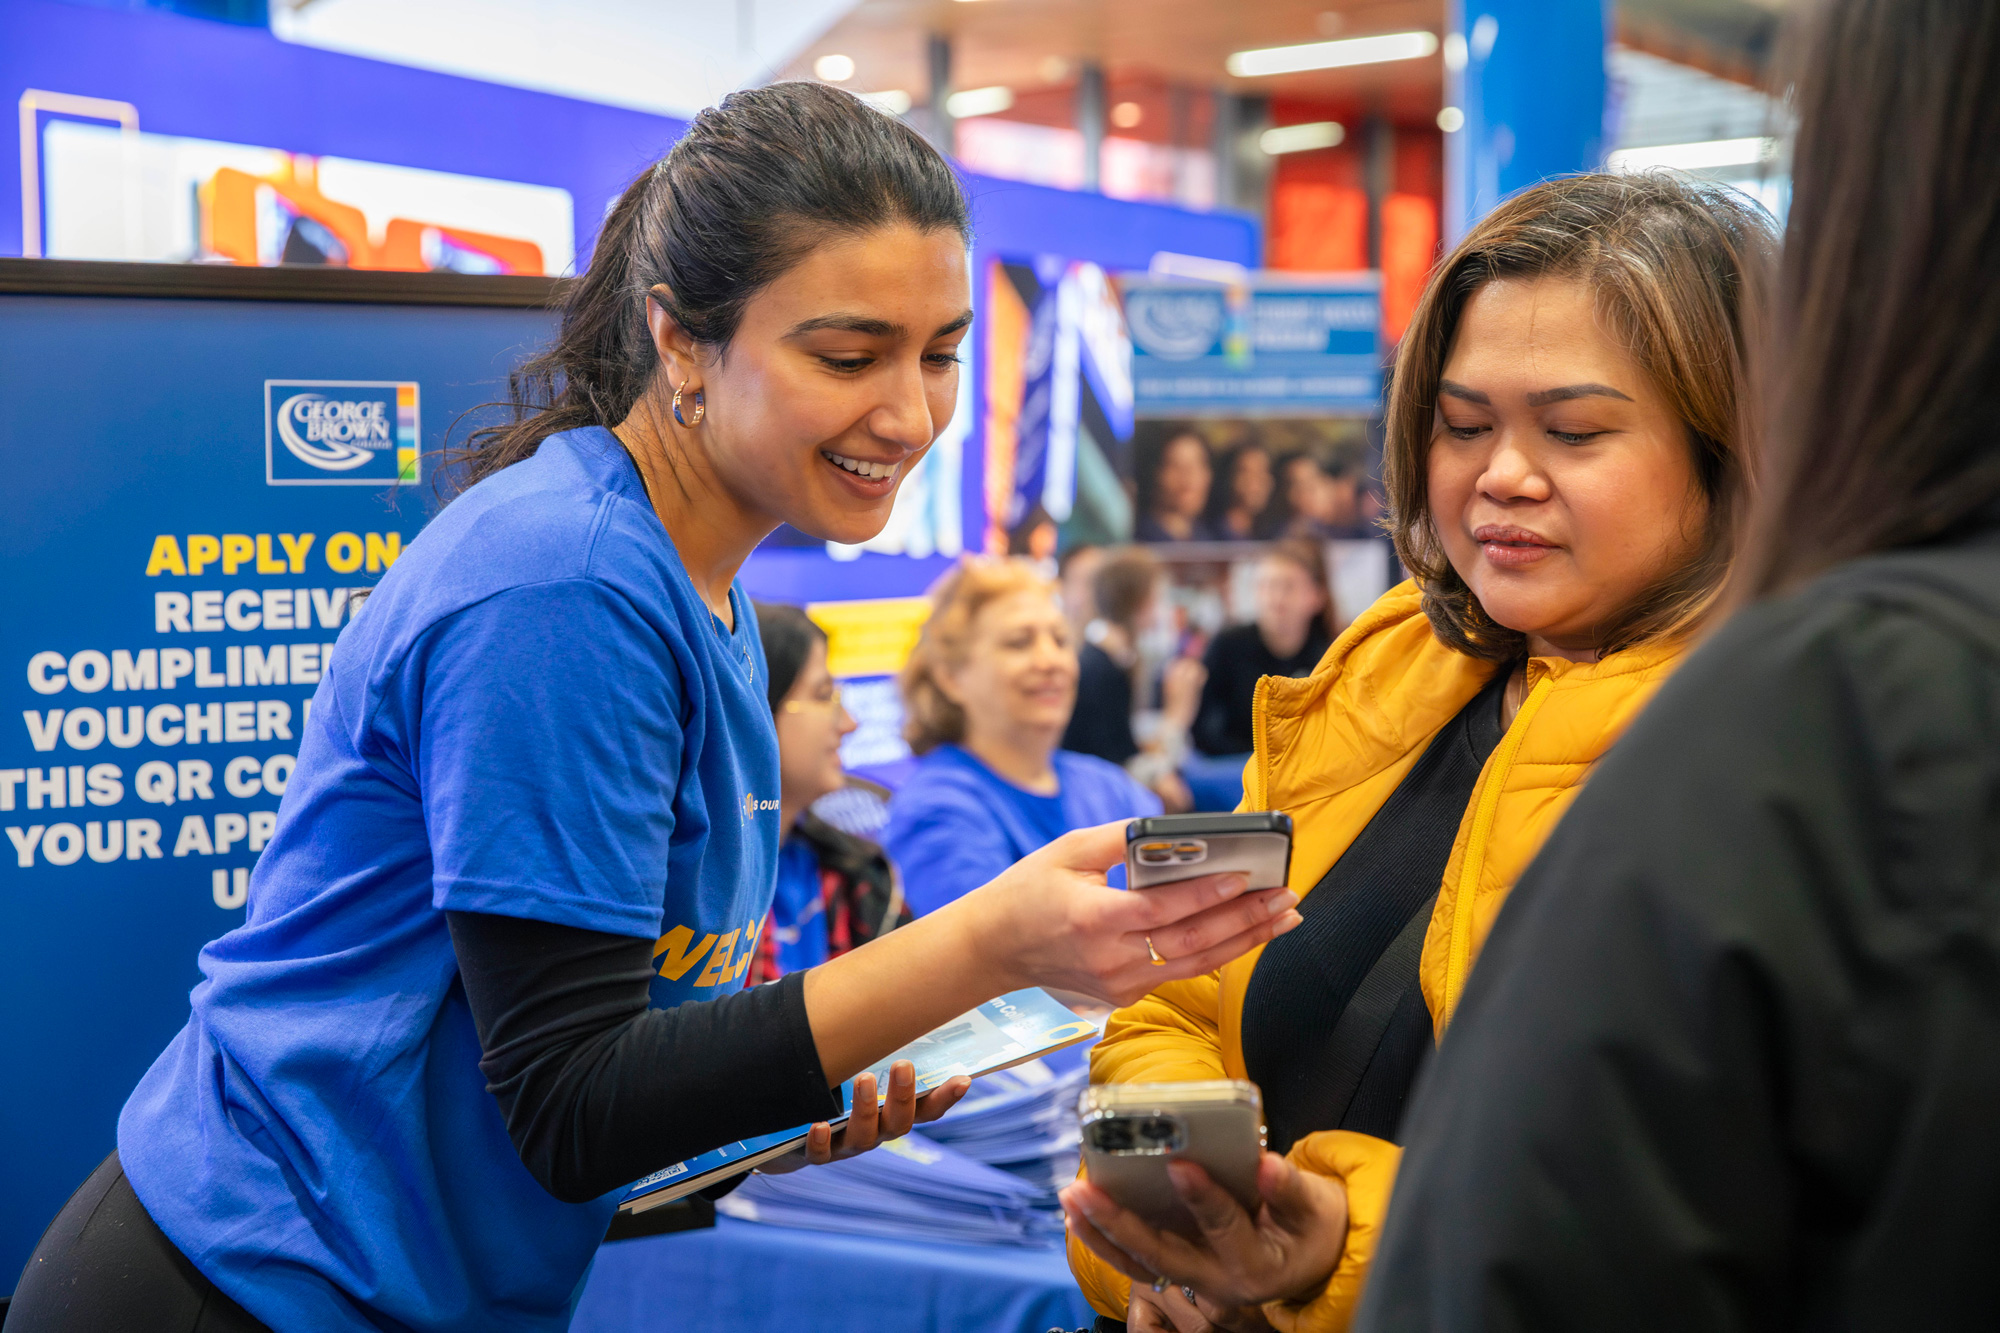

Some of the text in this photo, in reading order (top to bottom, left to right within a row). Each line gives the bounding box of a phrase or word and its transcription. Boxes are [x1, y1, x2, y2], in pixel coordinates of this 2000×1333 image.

[294, 400, 387, 423] GEORGE
[306, 418, 390, 442] BROWN
[145, 532, 316, 576] APPLY
[23, 700, 293, 752] VOUCHER
[0, 763, 124, 811] THIS
[134, 760, 215, 806] QR
[760, 799, 780, 811] OUR
[5, 818, 163, 867] YOUR
[653, 913, 767, 987] WELC
